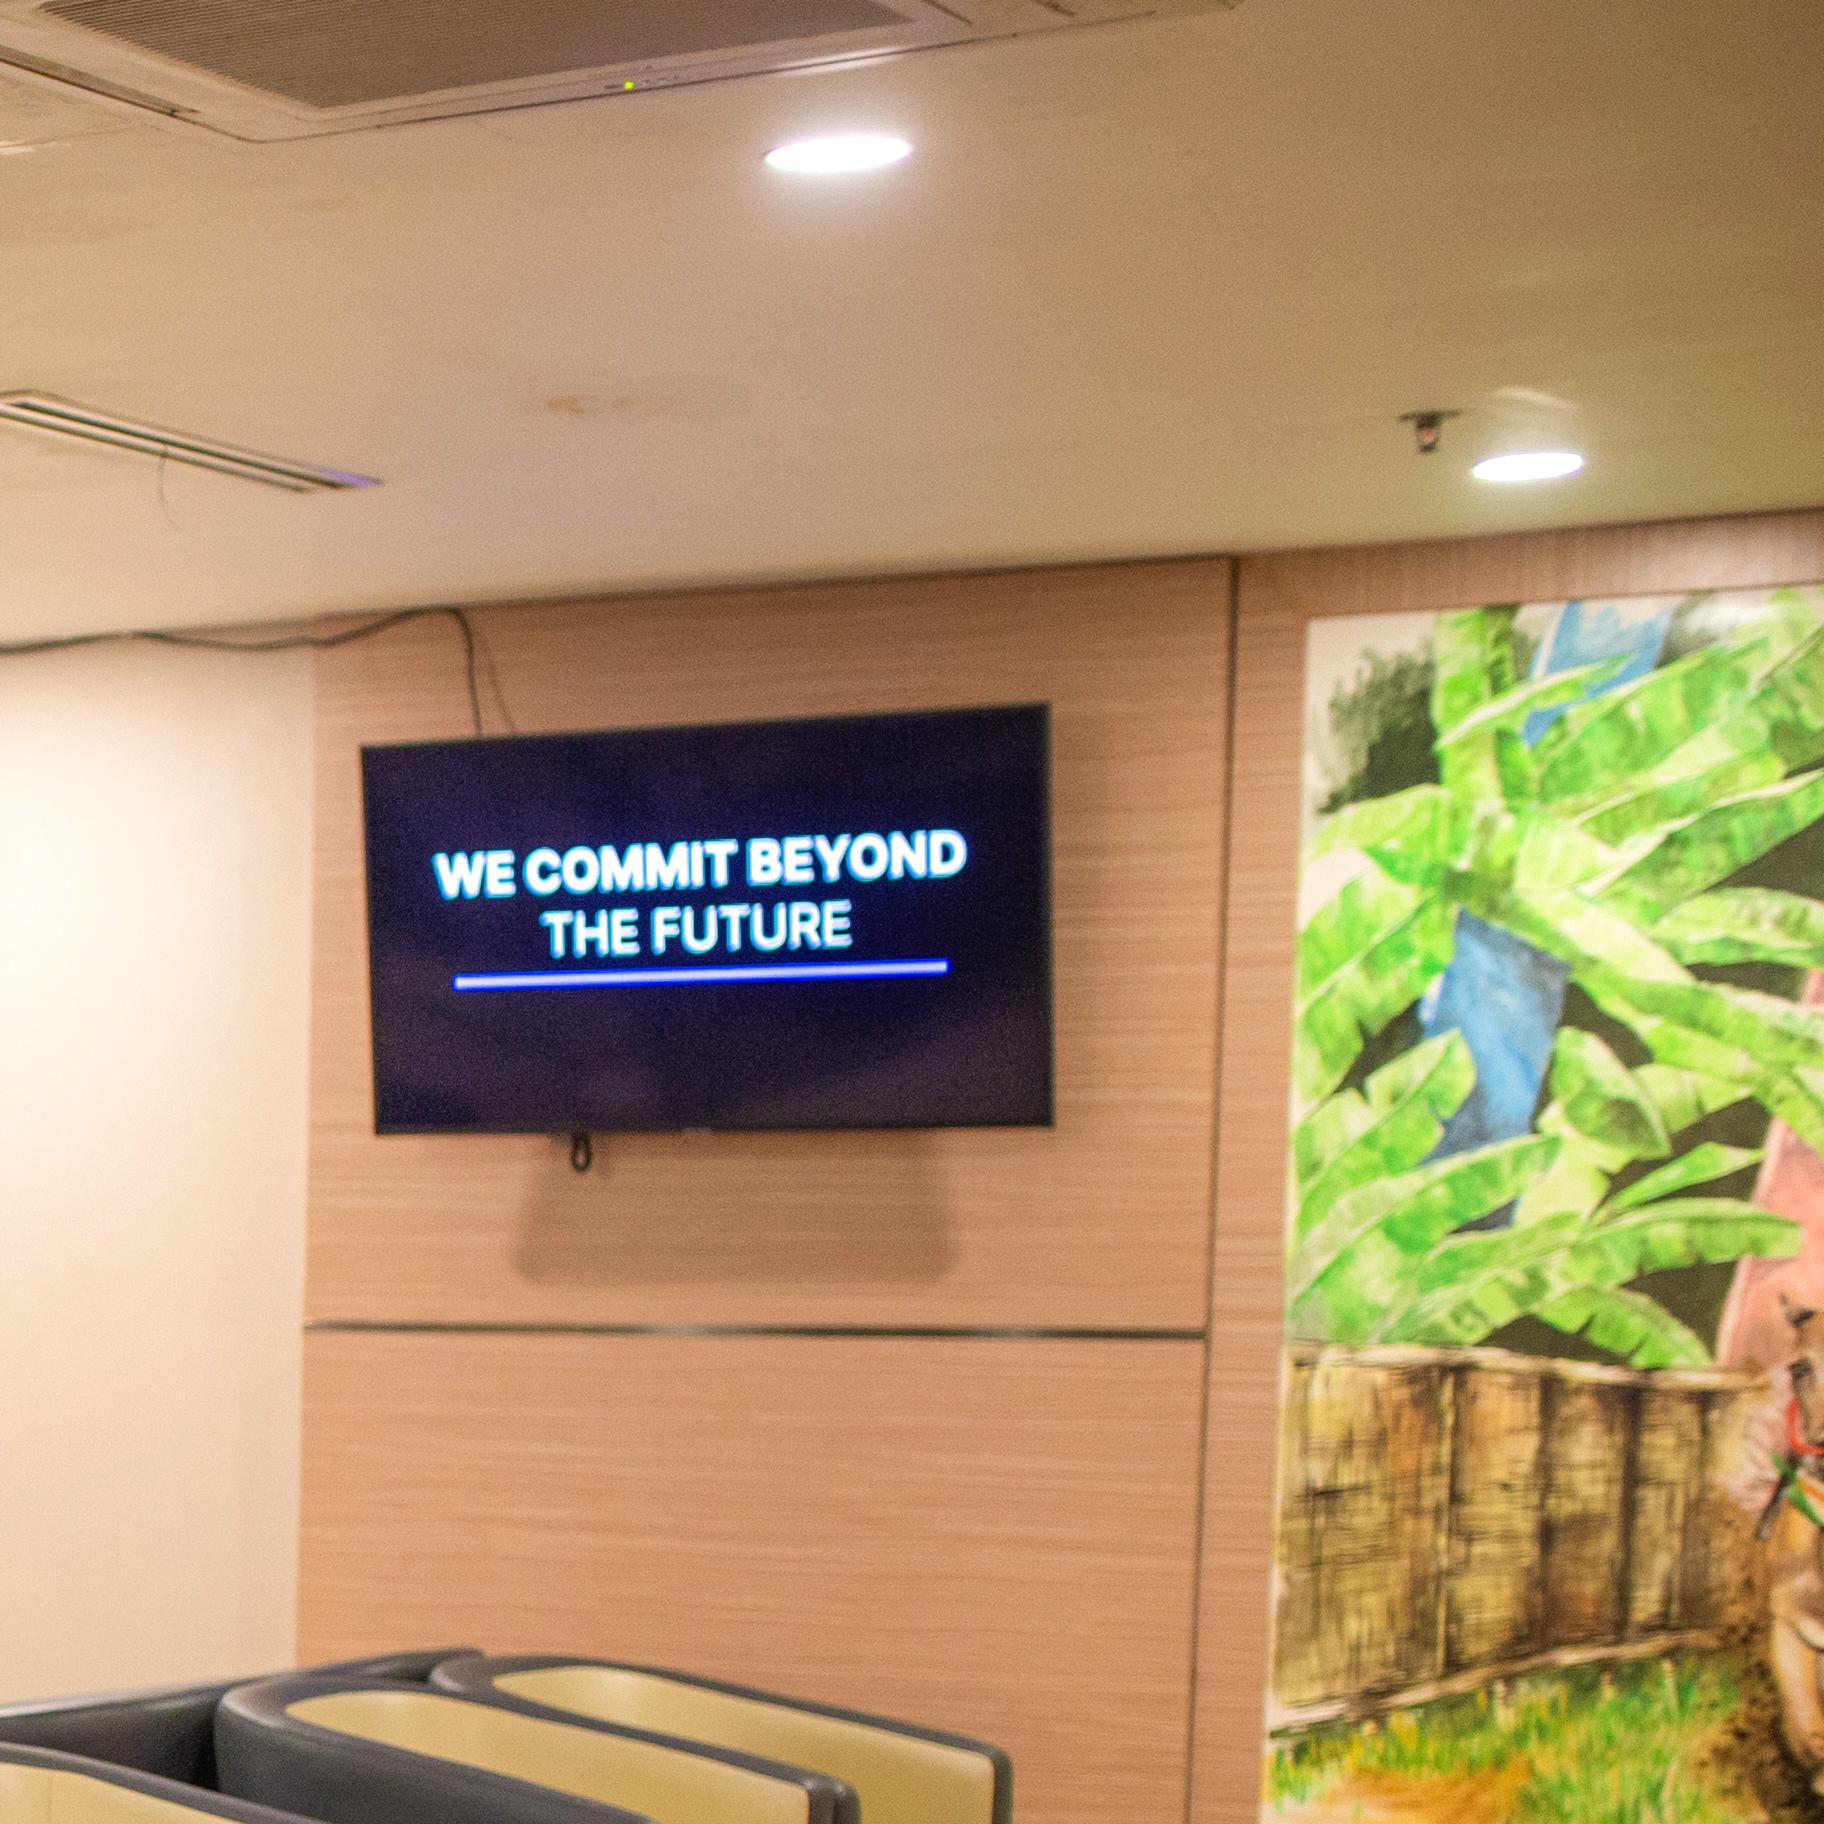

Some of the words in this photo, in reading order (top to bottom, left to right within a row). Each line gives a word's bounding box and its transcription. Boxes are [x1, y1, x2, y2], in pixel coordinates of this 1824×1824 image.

[432, 849, 516, 900] WE
[523, 839, 739, 895] COMMIT
[747, 829, 967, 887] BEYOND
[540, 907, 640, 958] THE
[651, 900, 853, 955] FUTURE
